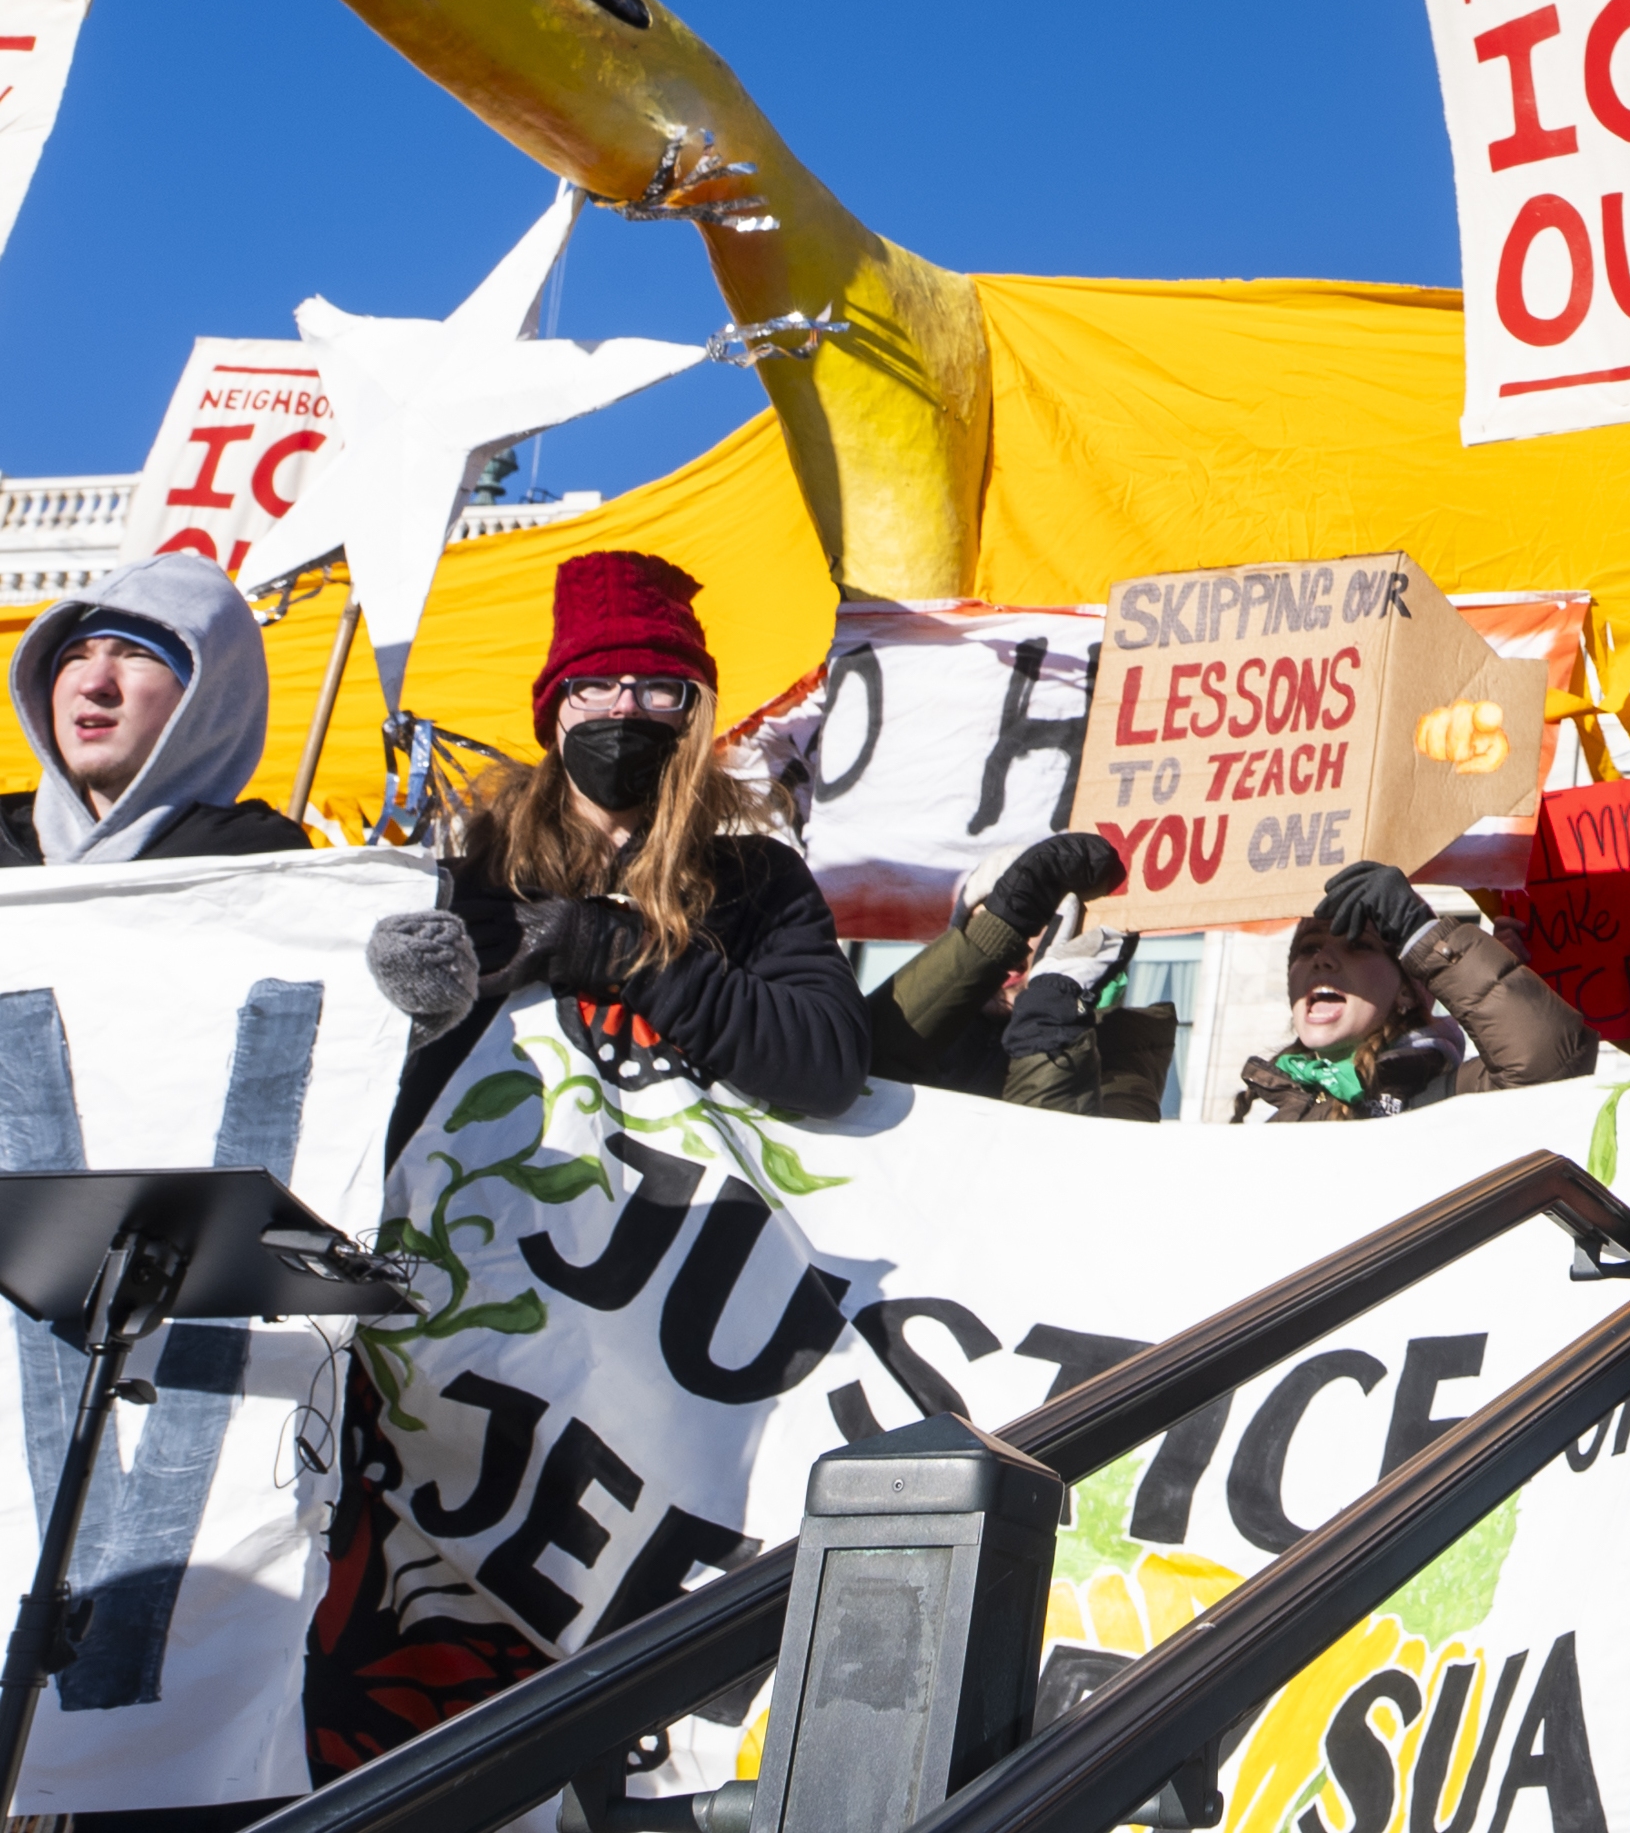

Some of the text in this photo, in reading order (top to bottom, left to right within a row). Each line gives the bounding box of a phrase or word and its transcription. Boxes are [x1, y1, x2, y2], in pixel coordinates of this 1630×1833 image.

[199, 389, 334, 419] NEIGHBO
[165, 423, 334, 519] IC
[1113, 566, 1413, 650] SKIPPING OUR
[1114, 644, 1361, 747] LESSONS
[1109, 741, 1349, 808] TO TEACH
[1094, 808, 1352, 897] YOU ONE
